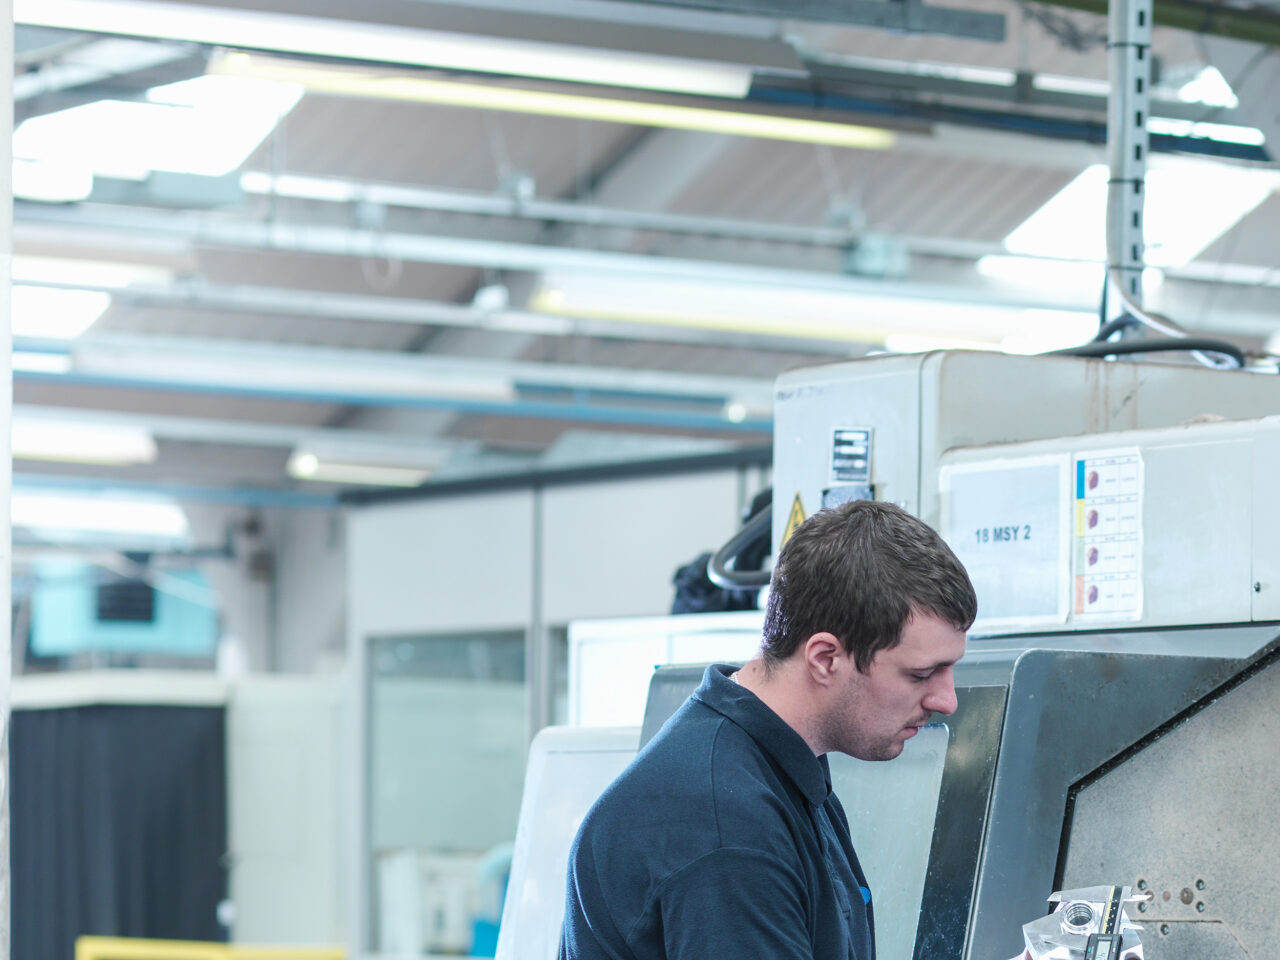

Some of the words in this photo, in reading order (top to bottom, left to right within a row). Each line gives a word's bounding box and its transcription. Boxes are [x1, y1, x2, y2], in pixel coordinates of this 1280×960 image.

[976, 529, 989, 544] 18
[994, 525, 1020, 542] MSY
[1024, 525, 1030, 539] 2
